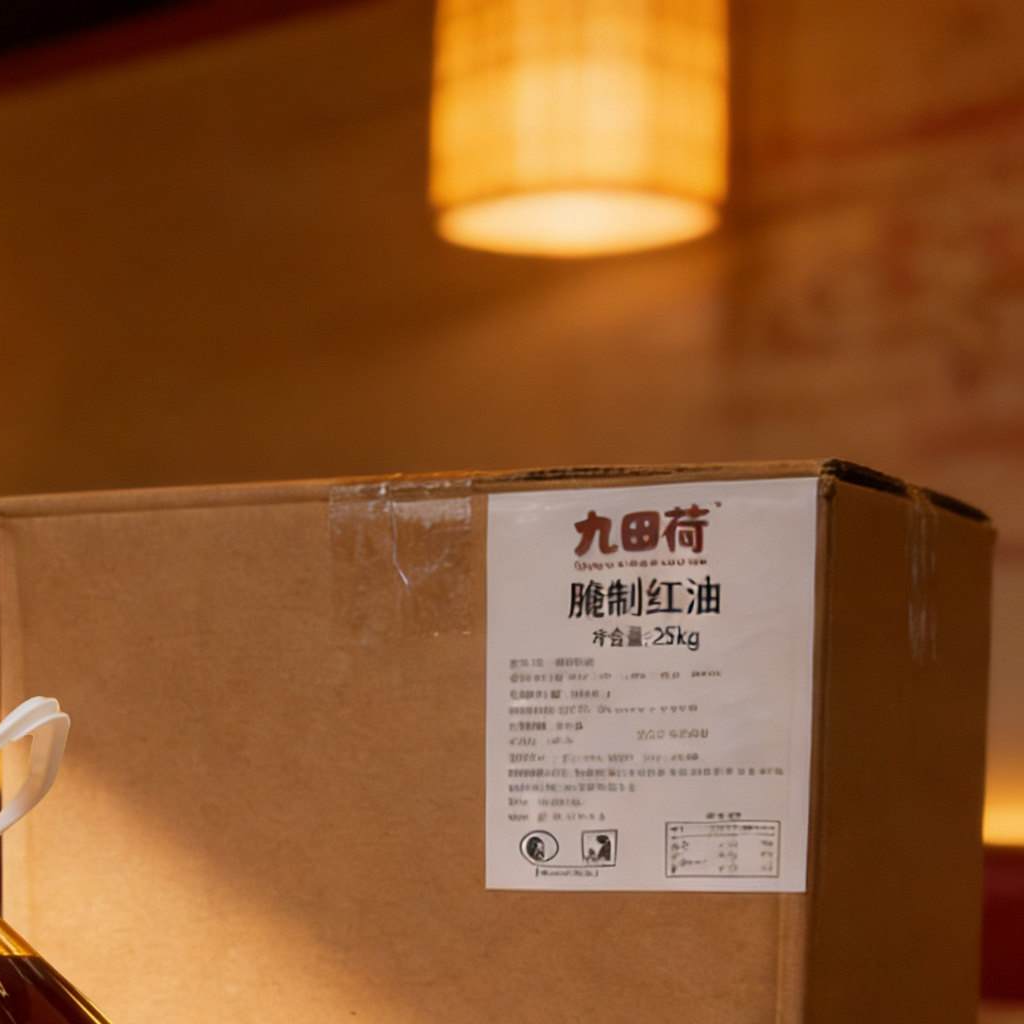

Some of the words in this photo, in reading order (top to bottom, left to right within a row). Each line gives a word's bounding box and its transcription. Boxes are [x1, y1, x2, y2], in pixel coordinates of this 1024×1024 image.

[574, 504, 710, 557] 九田荷
[568, 575, 721, 619] 腌制红油
